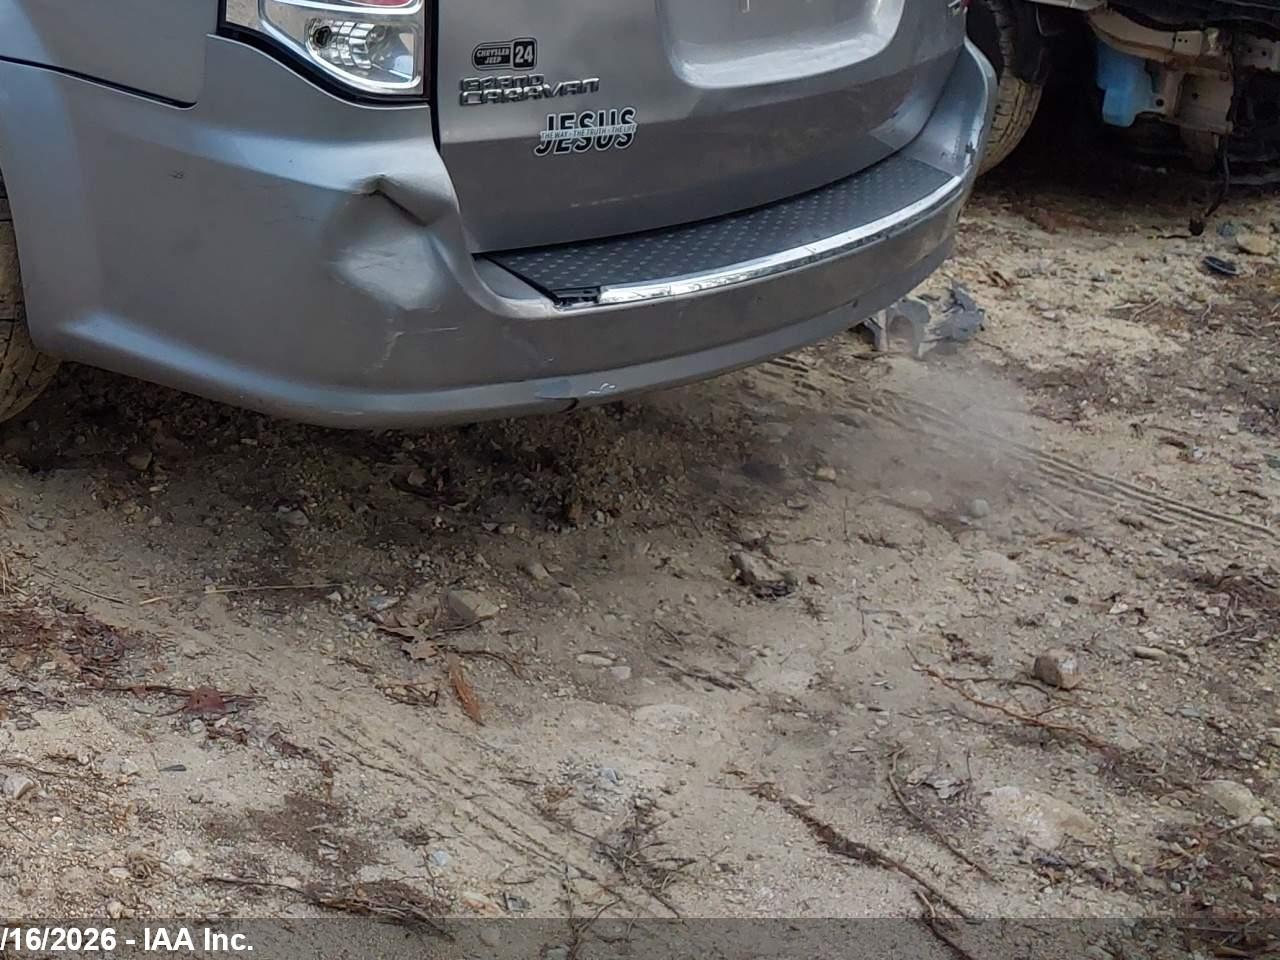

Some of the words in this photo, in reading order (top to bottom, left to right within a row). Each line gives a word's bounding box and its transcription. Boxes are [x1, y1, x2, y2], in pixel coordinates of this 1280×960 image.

[476, 47, 510, 58] CHRYSLER
[484, 56, 502, 64] JEEP
[514, 44, 534, 64] 24
[459, 77, 600, 106] CARAVAN
[460, 73, 545, 91] GRAND
[534, 107, 637, 156] JESUS
